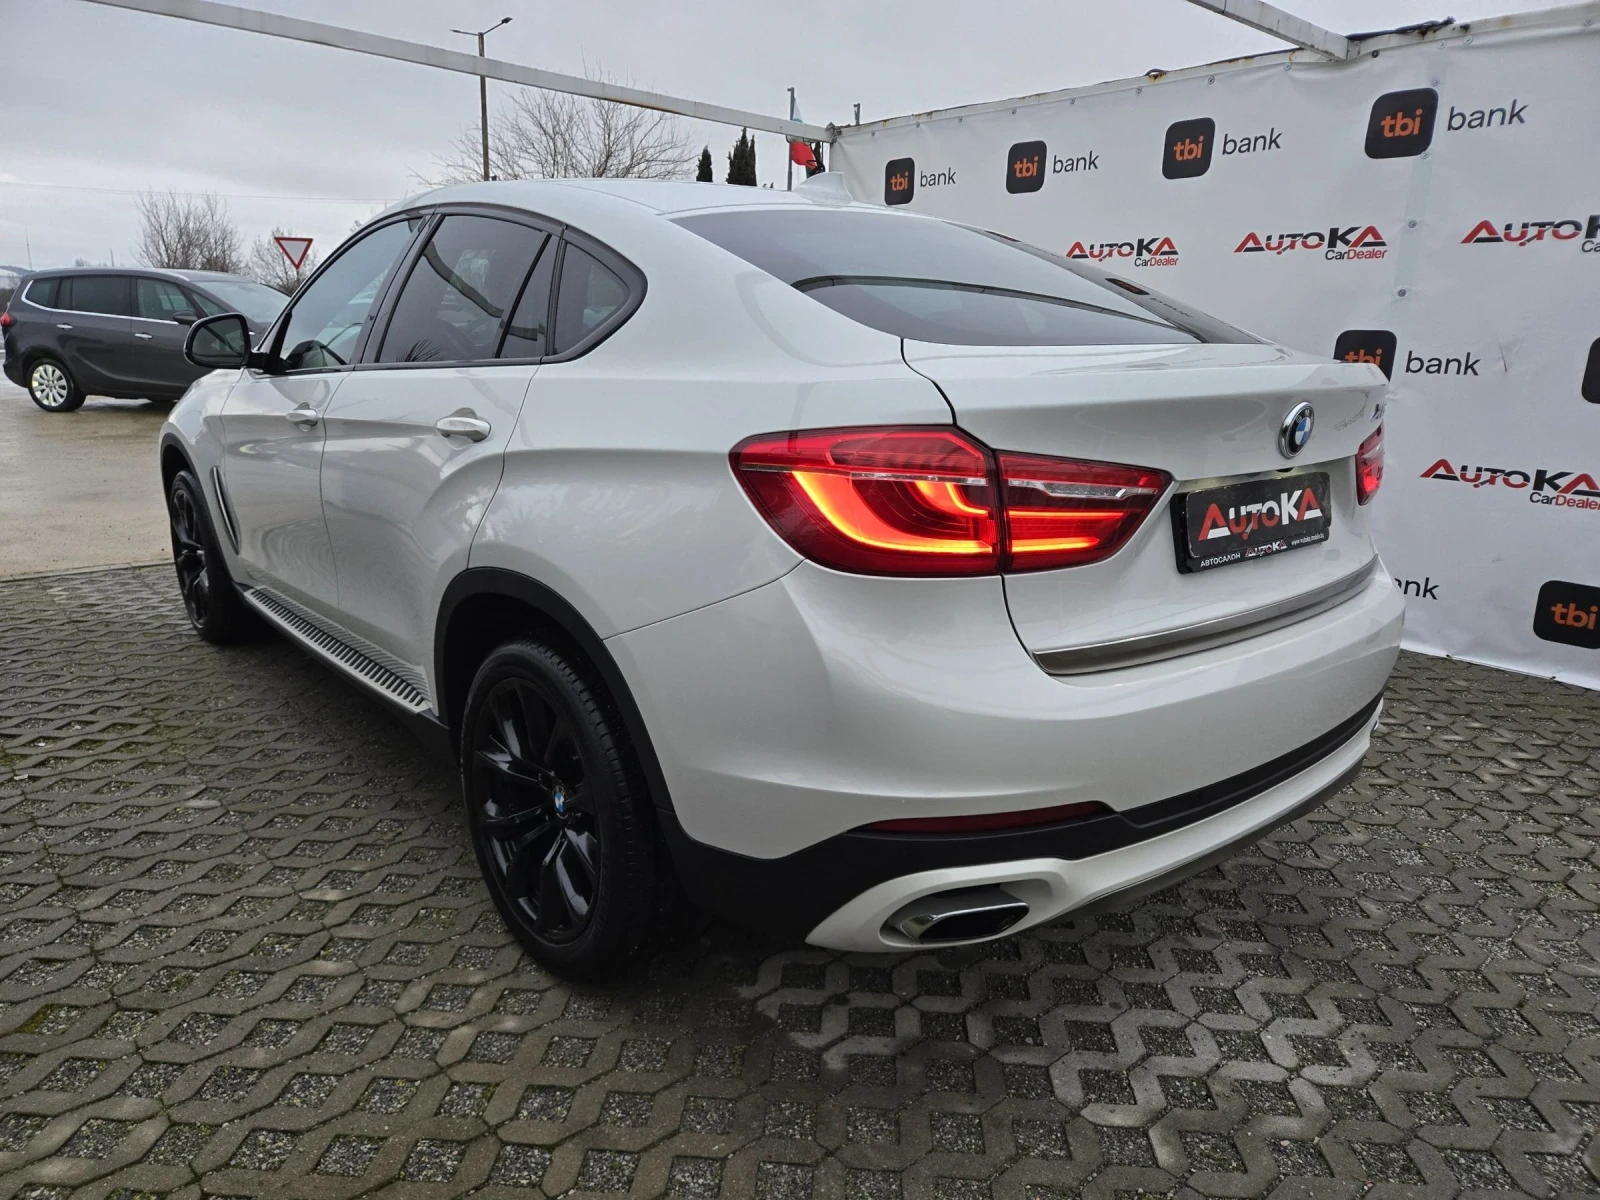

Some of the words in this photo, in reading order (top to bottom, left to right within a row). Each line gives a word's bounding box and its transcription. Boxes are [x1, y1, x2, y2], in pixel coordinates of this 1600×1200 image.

[1381, 109, 1423, 137] tbi
[1447, 99, 1528, 131] bank
[1173, 135, 1204, 161] tbi
[1222, 128, 1283, 155] bank
[1014, 156, 1039, 178] tbi
[1052, 150, 1099, 174] bank
[891, 173, 909, 191] tbi
[920, 167, 956, 187] bank
[1134, 255, 1179, 268] CarDealer
[1325, 248, 1388, 261] CarDealer
[1405, 350, 1481, 376] bank
[1200, 552, 1241, 568] АВТОСАЛОН
[1551, 603, 1599, 630] tbi
